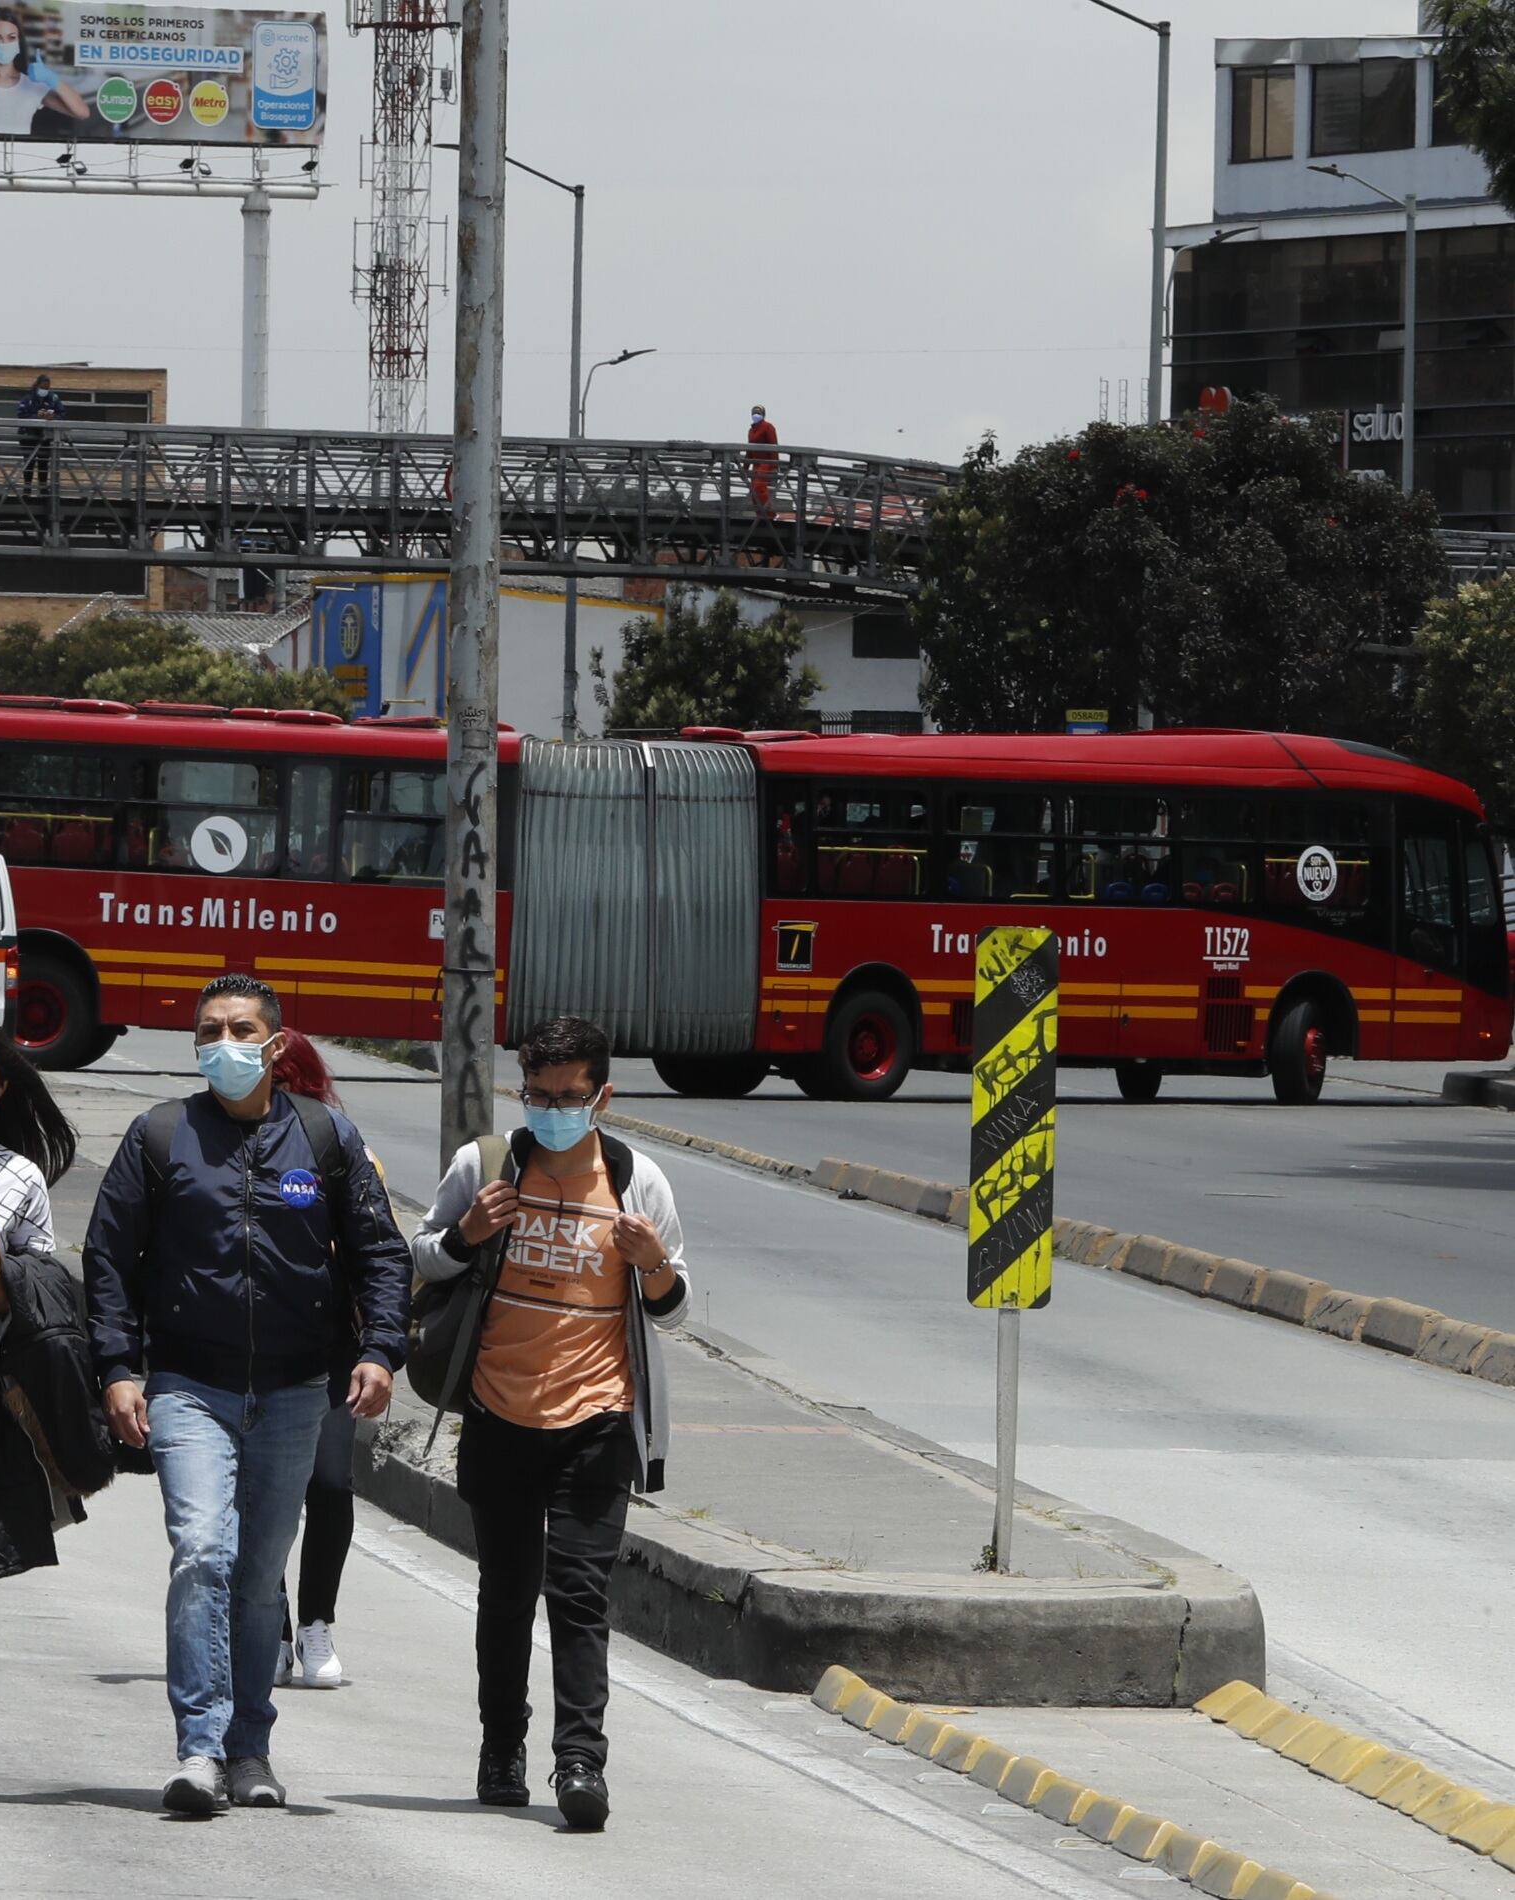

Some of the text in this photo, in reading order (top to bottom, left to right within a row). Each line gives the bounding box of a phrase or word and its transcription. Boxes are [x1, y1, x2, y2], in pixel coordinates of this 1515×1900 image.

[80, 15, 205, 29] SOMOS LOS PRIMEROS
[80, 29, 187, 42] EN CERTIFICARNOS
[277, 33, 309, 43] icontec
[79, 45, 241, 65] EN BIOSEGURIDAD
[147, 95, 180, 109] easy
[192, 97, 226, 109] Metro
[257, 100, 310, 111] Operaciones
[260, 111, 307, 124] Bioseguras
[1352, 402, 1405, 442] salud
[1304, 866, 1331, 881] NUEVO
[99, 892, 338, 934] TransMilenio
[1204, 926, 1250, 956] T1572
[282, 1184, 316, 1196] NASA
[510, 1210, 602, 1249] DARK
